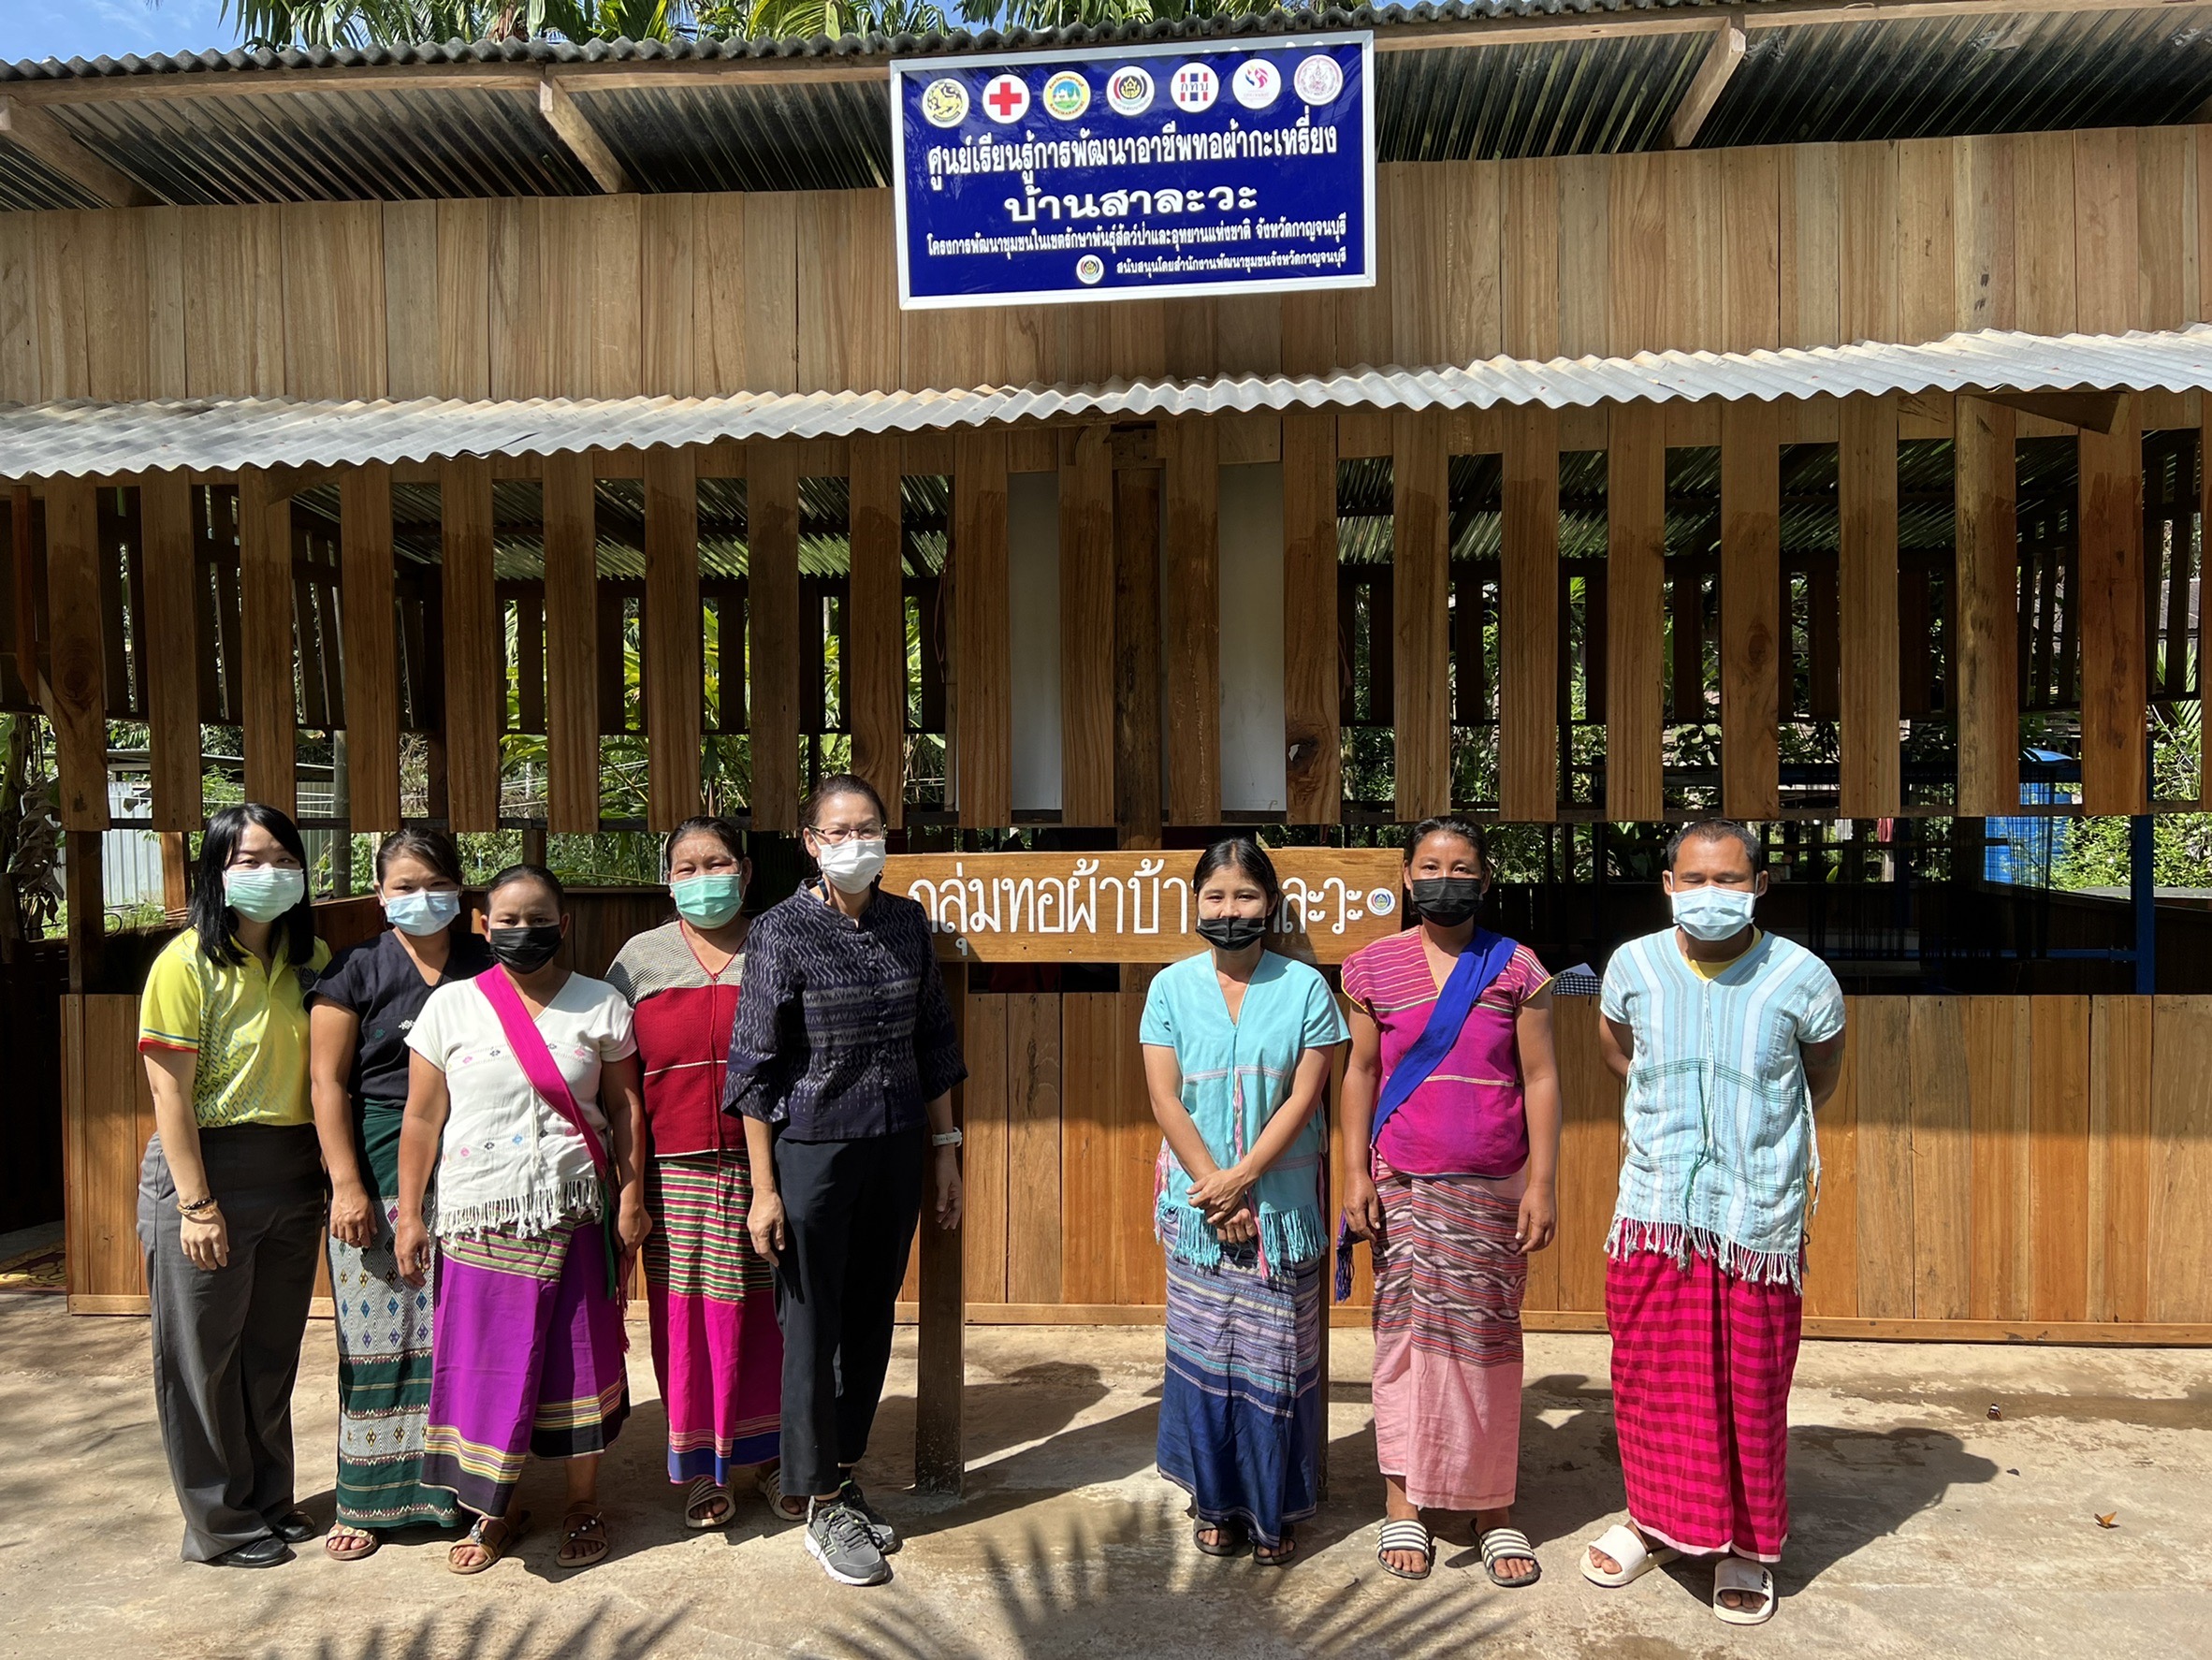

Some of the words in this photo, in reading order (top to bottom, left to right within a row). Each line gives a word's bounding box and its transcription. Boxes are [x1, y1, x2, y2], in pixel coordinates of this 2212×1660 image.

[928, 105, 1337, 191] ศูนย์เรียนรู้การพัฒนาอาชีพทอผ้ากะเหรี่ยง
[1004, 184, 1258, 222] บ้านสาละวะ
[926, 217, 1251, 260] โครงการพัฒนาชุมชนในเขตรักษาพันธุ์สัตว์ป่าและอุทยานแห่งชาติ
[1256, 212, 1346, 243] จังหวัดกาญจนบุรี
[1116, 246, 1346, 278] สนับสนุนโดยสำนักงานพัฒนาชุมชนจังหวัดกาญจนบุรี
